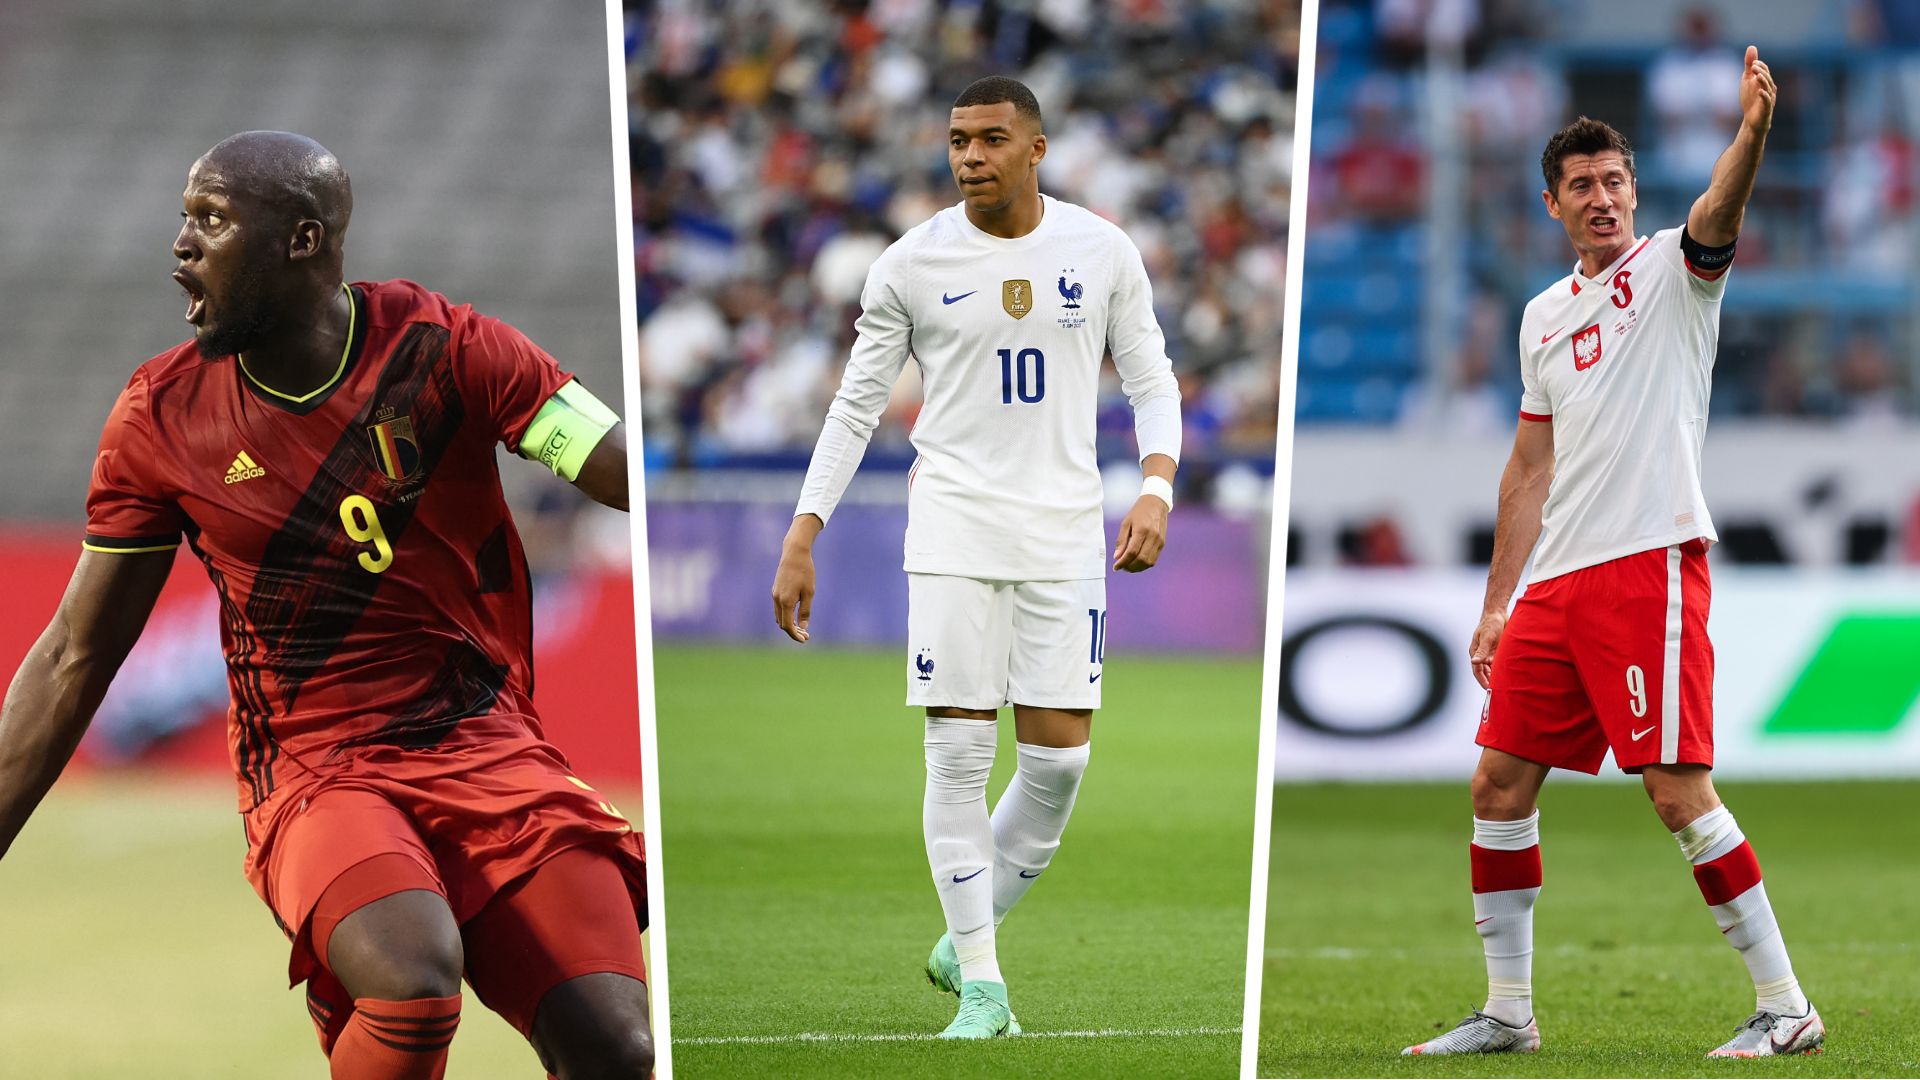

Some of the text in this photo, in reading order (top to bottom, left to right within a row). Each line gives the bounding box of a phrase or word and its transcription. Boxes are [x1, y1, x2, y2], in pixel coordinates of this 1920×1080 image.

[997, 348, 1045, 404] 10
[224, 467, 266, 484] adidas
[339, 494, 393, 573] 9
[1626, 665, 1648, 718] 9
